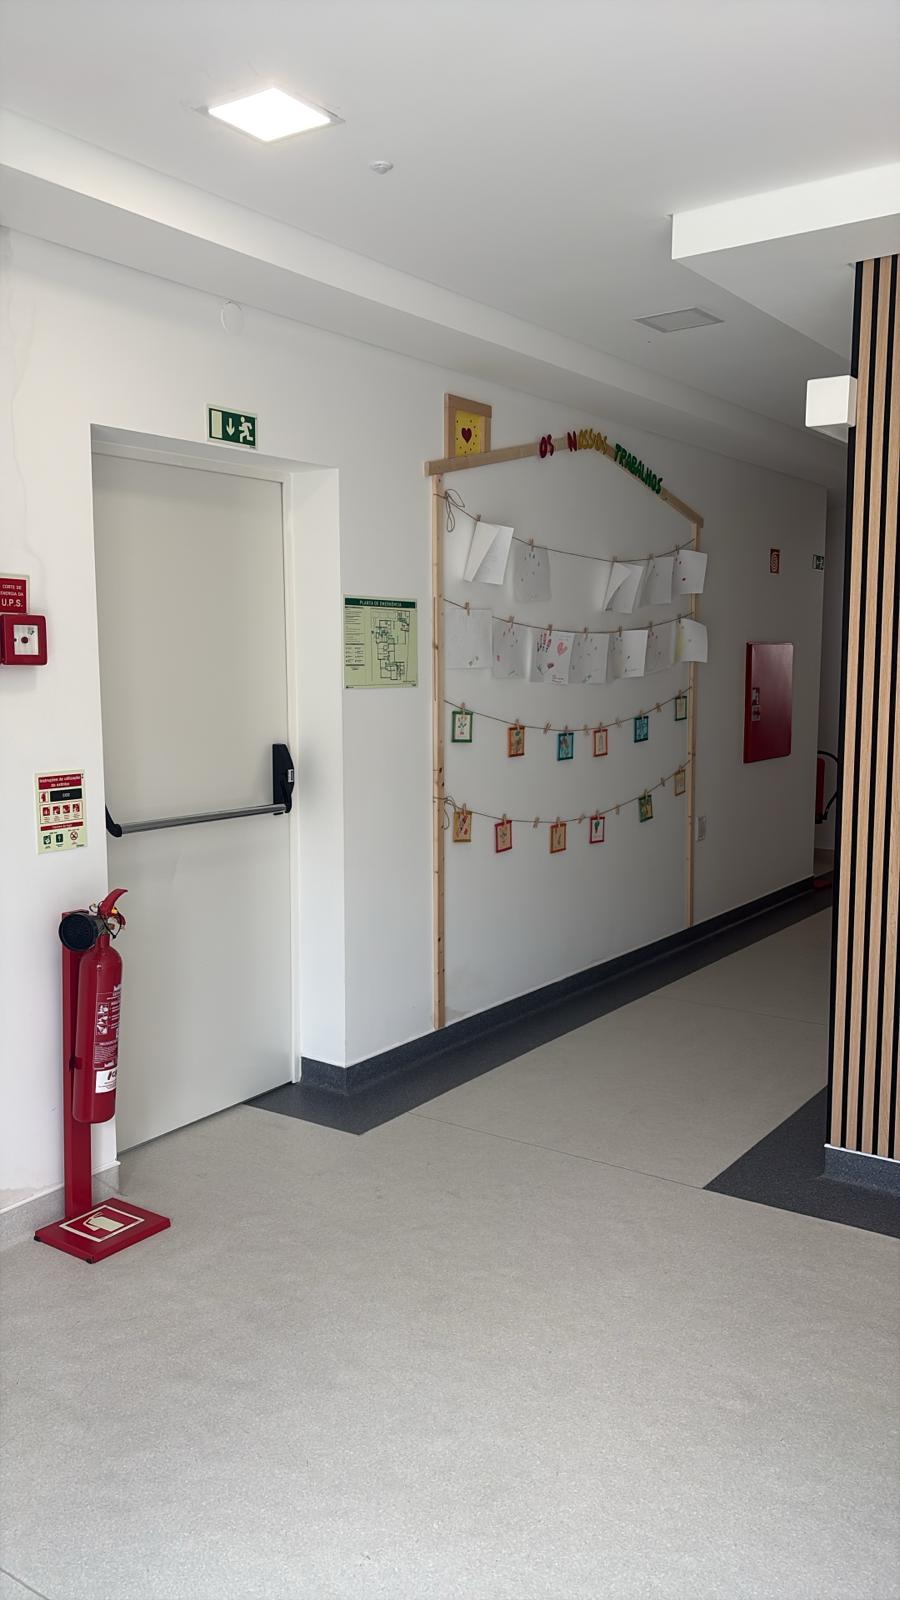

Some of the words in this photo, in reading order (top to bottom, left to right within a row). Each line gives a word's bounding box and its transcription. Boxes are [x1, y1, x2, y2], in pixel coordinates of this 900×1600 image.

[539, 434, 554, 458] OS
[567, 429, 607, 455] NOSSOS
[614, 443, 663, 494] TRABALHOS
[2, 598, 23, 607] U.P.S.
